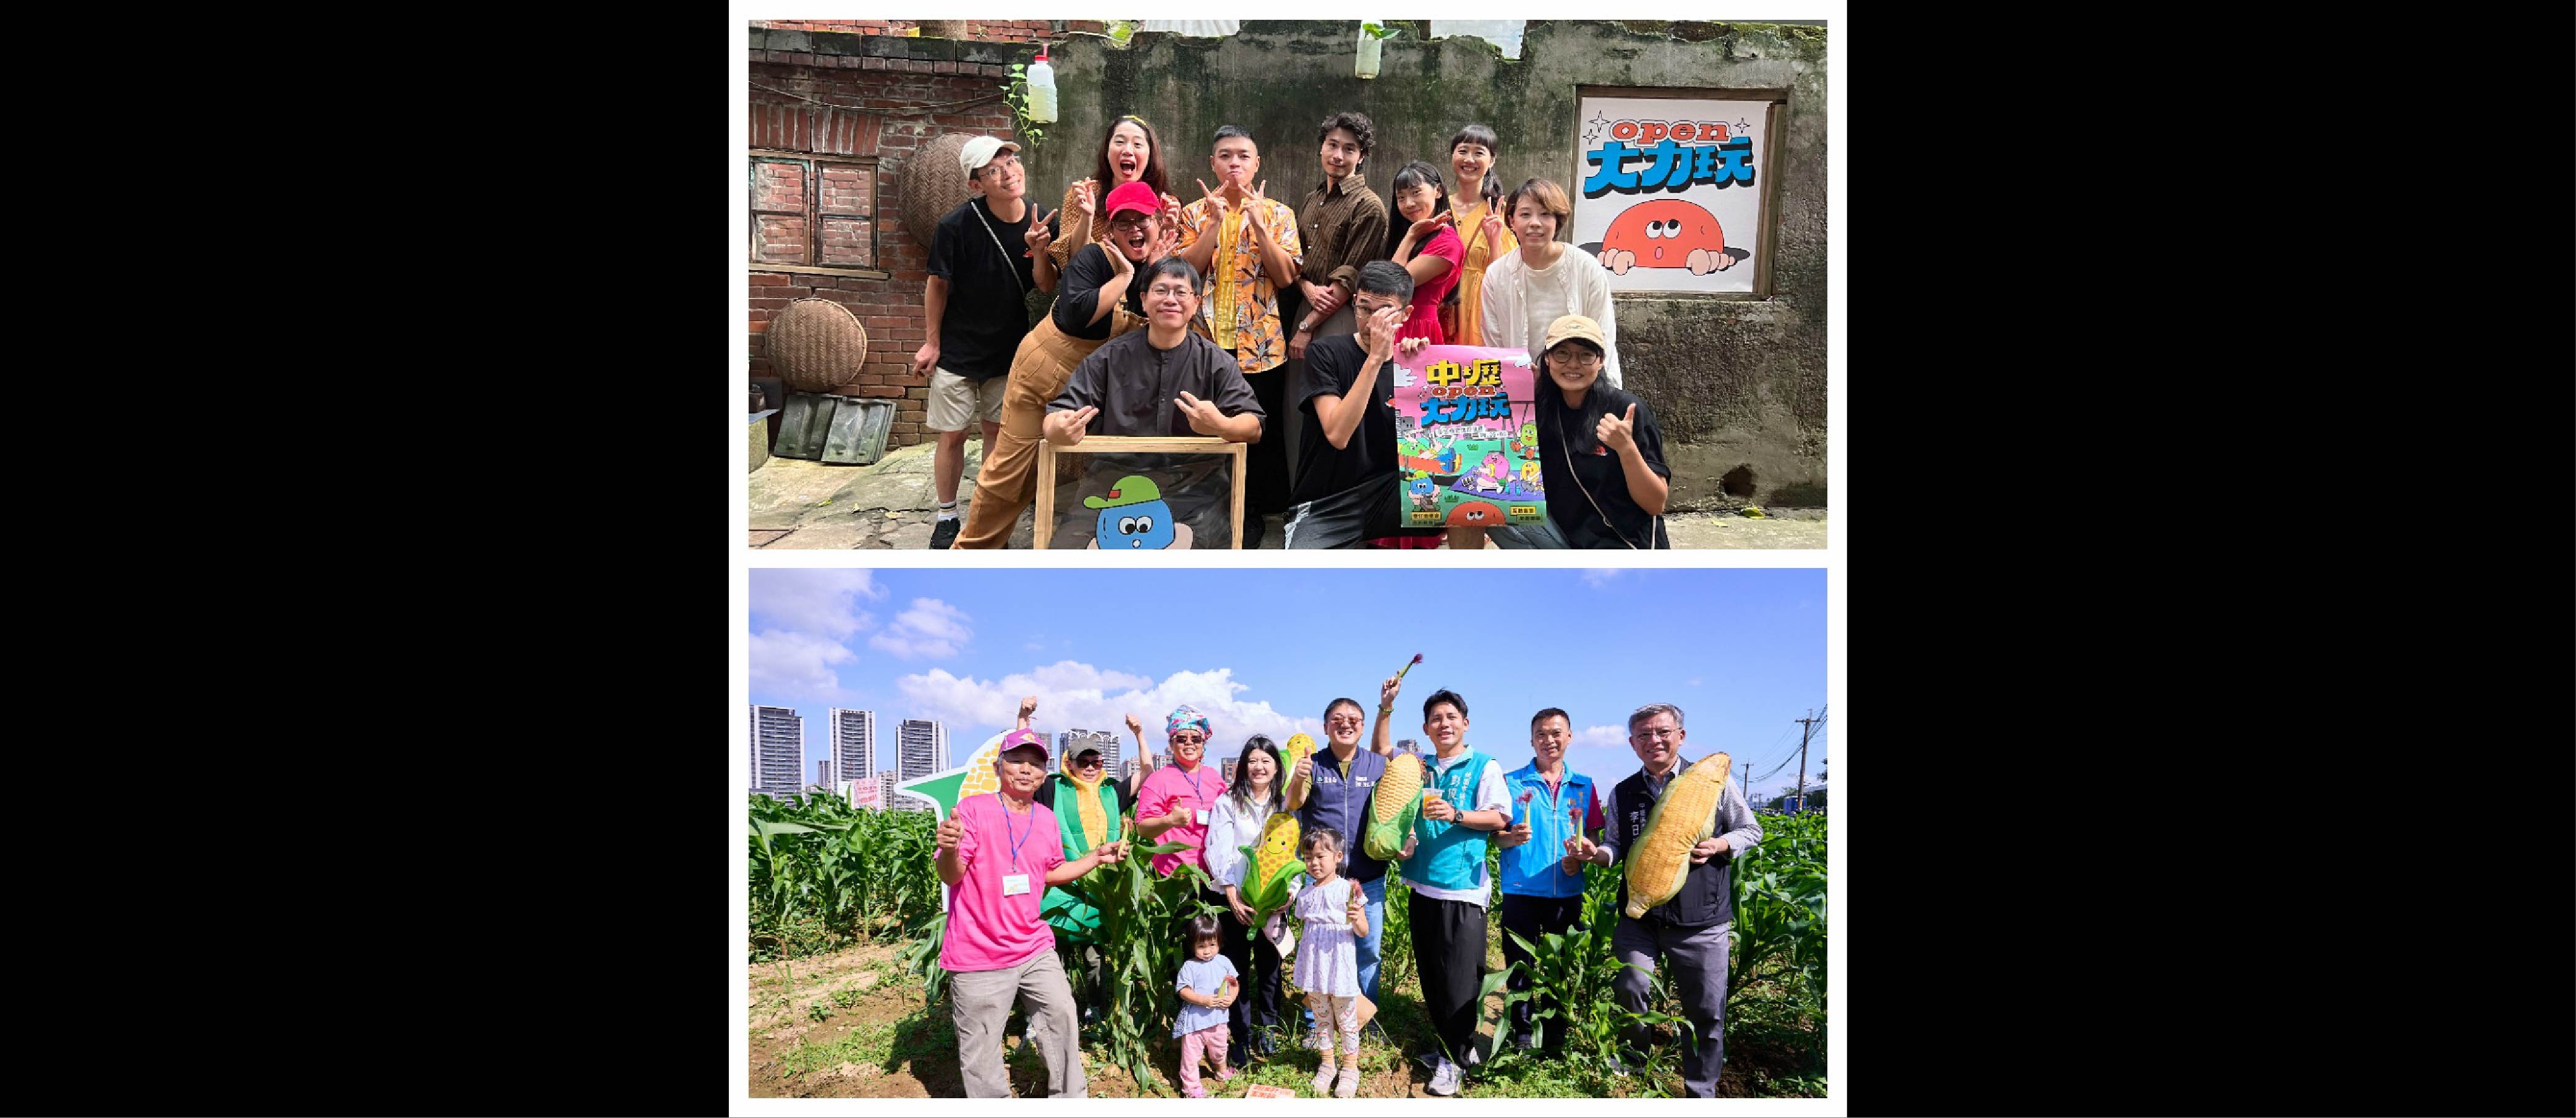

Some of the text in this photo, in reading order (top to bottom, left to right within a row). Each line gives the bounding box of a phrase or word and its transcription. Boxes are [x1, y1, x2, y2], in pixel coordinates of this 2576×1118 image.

[1610, 120, 1732, 146] open
[1584, 137, 1755, 198] 大力玩
[1426, 358, 1502, 386] 中壢
[1432, 386, 1496, 399] open
[1420, 392, 1512, 426] 大力玩
